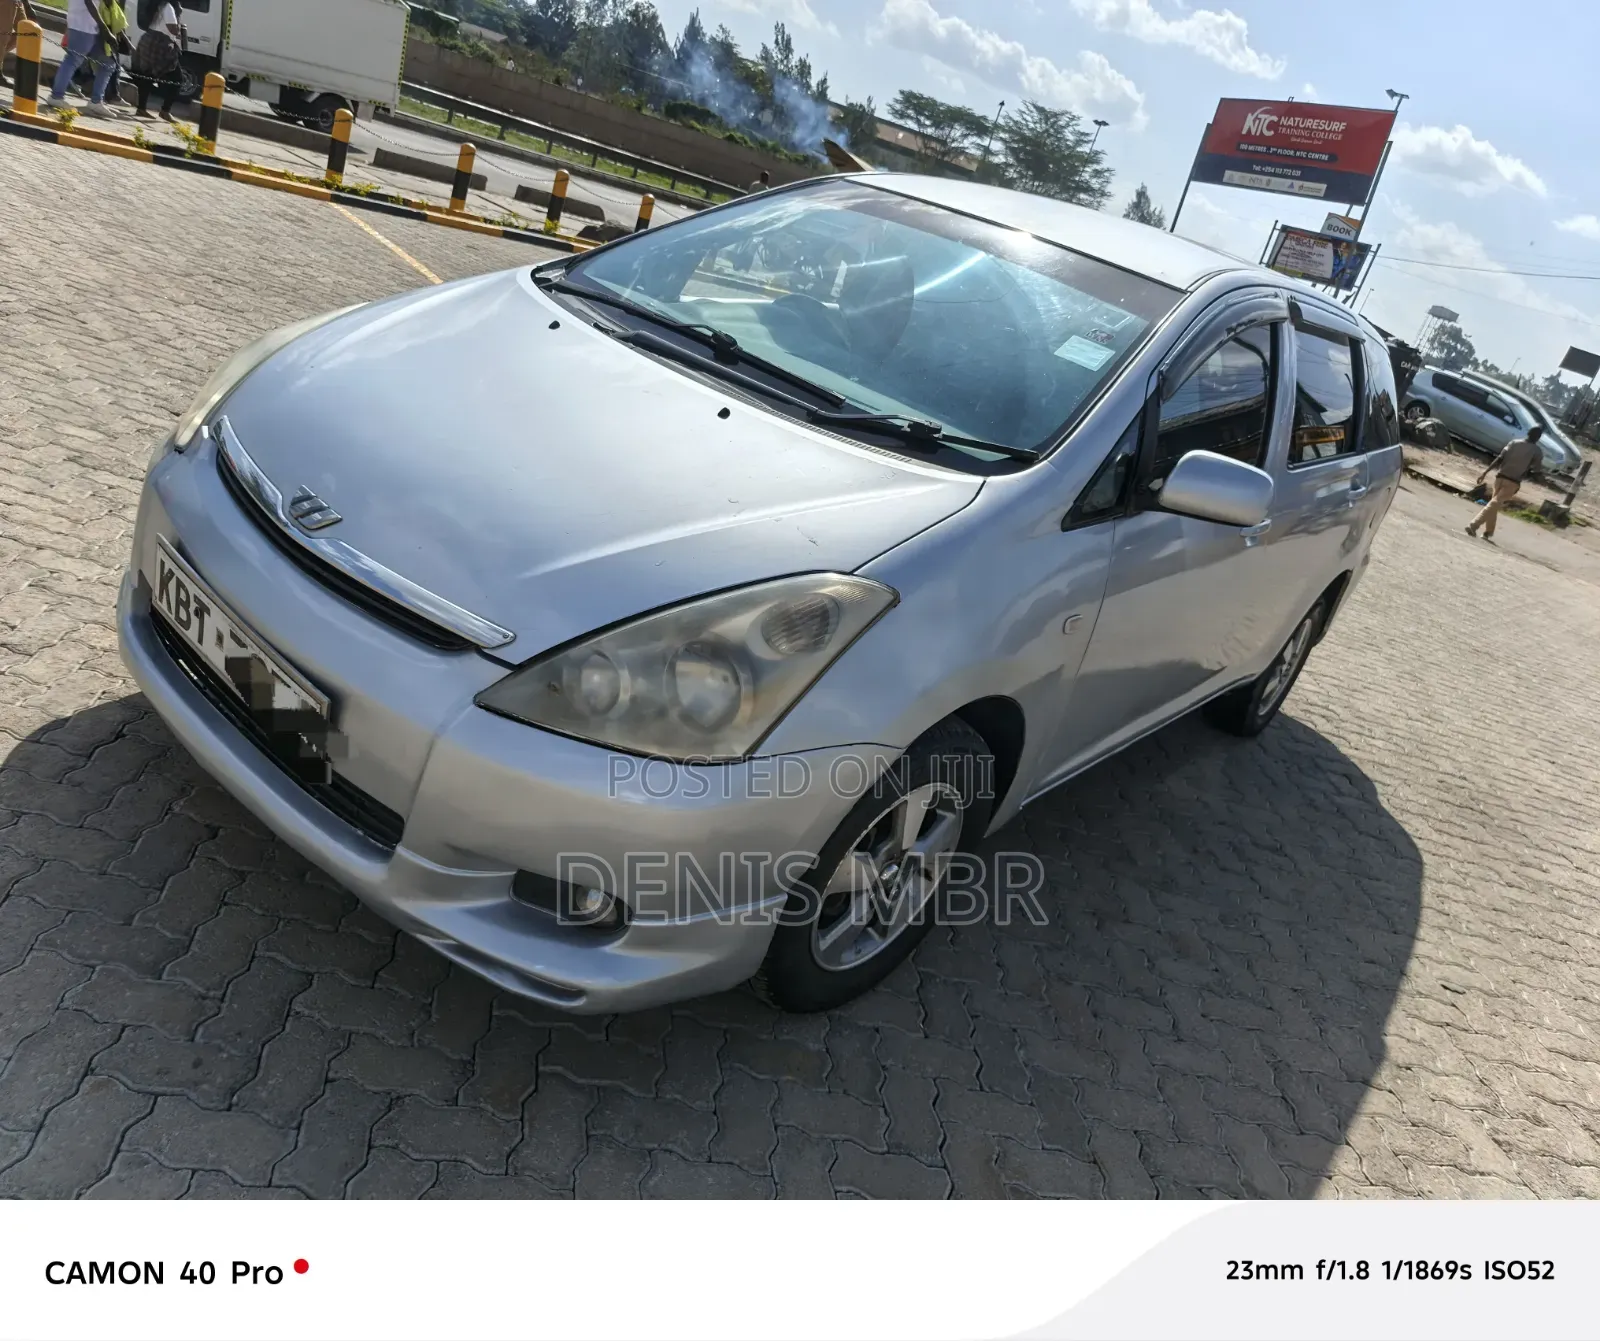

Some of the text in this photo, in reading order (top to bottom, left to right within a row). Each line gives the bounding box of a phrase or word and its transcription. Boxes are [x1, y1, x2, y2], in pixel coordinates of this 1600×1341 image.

[1279, 116, 1347, 132] NATURESURF
[1278, 127, 1310, 138] TRAINING
[1311, 131, 1343, 141] COLLEGE
[1307, 152, 1329, 161] CENTRE
[1327, 223, 1352, 236] BOOK
[158, 557, 211, 647] KBT
